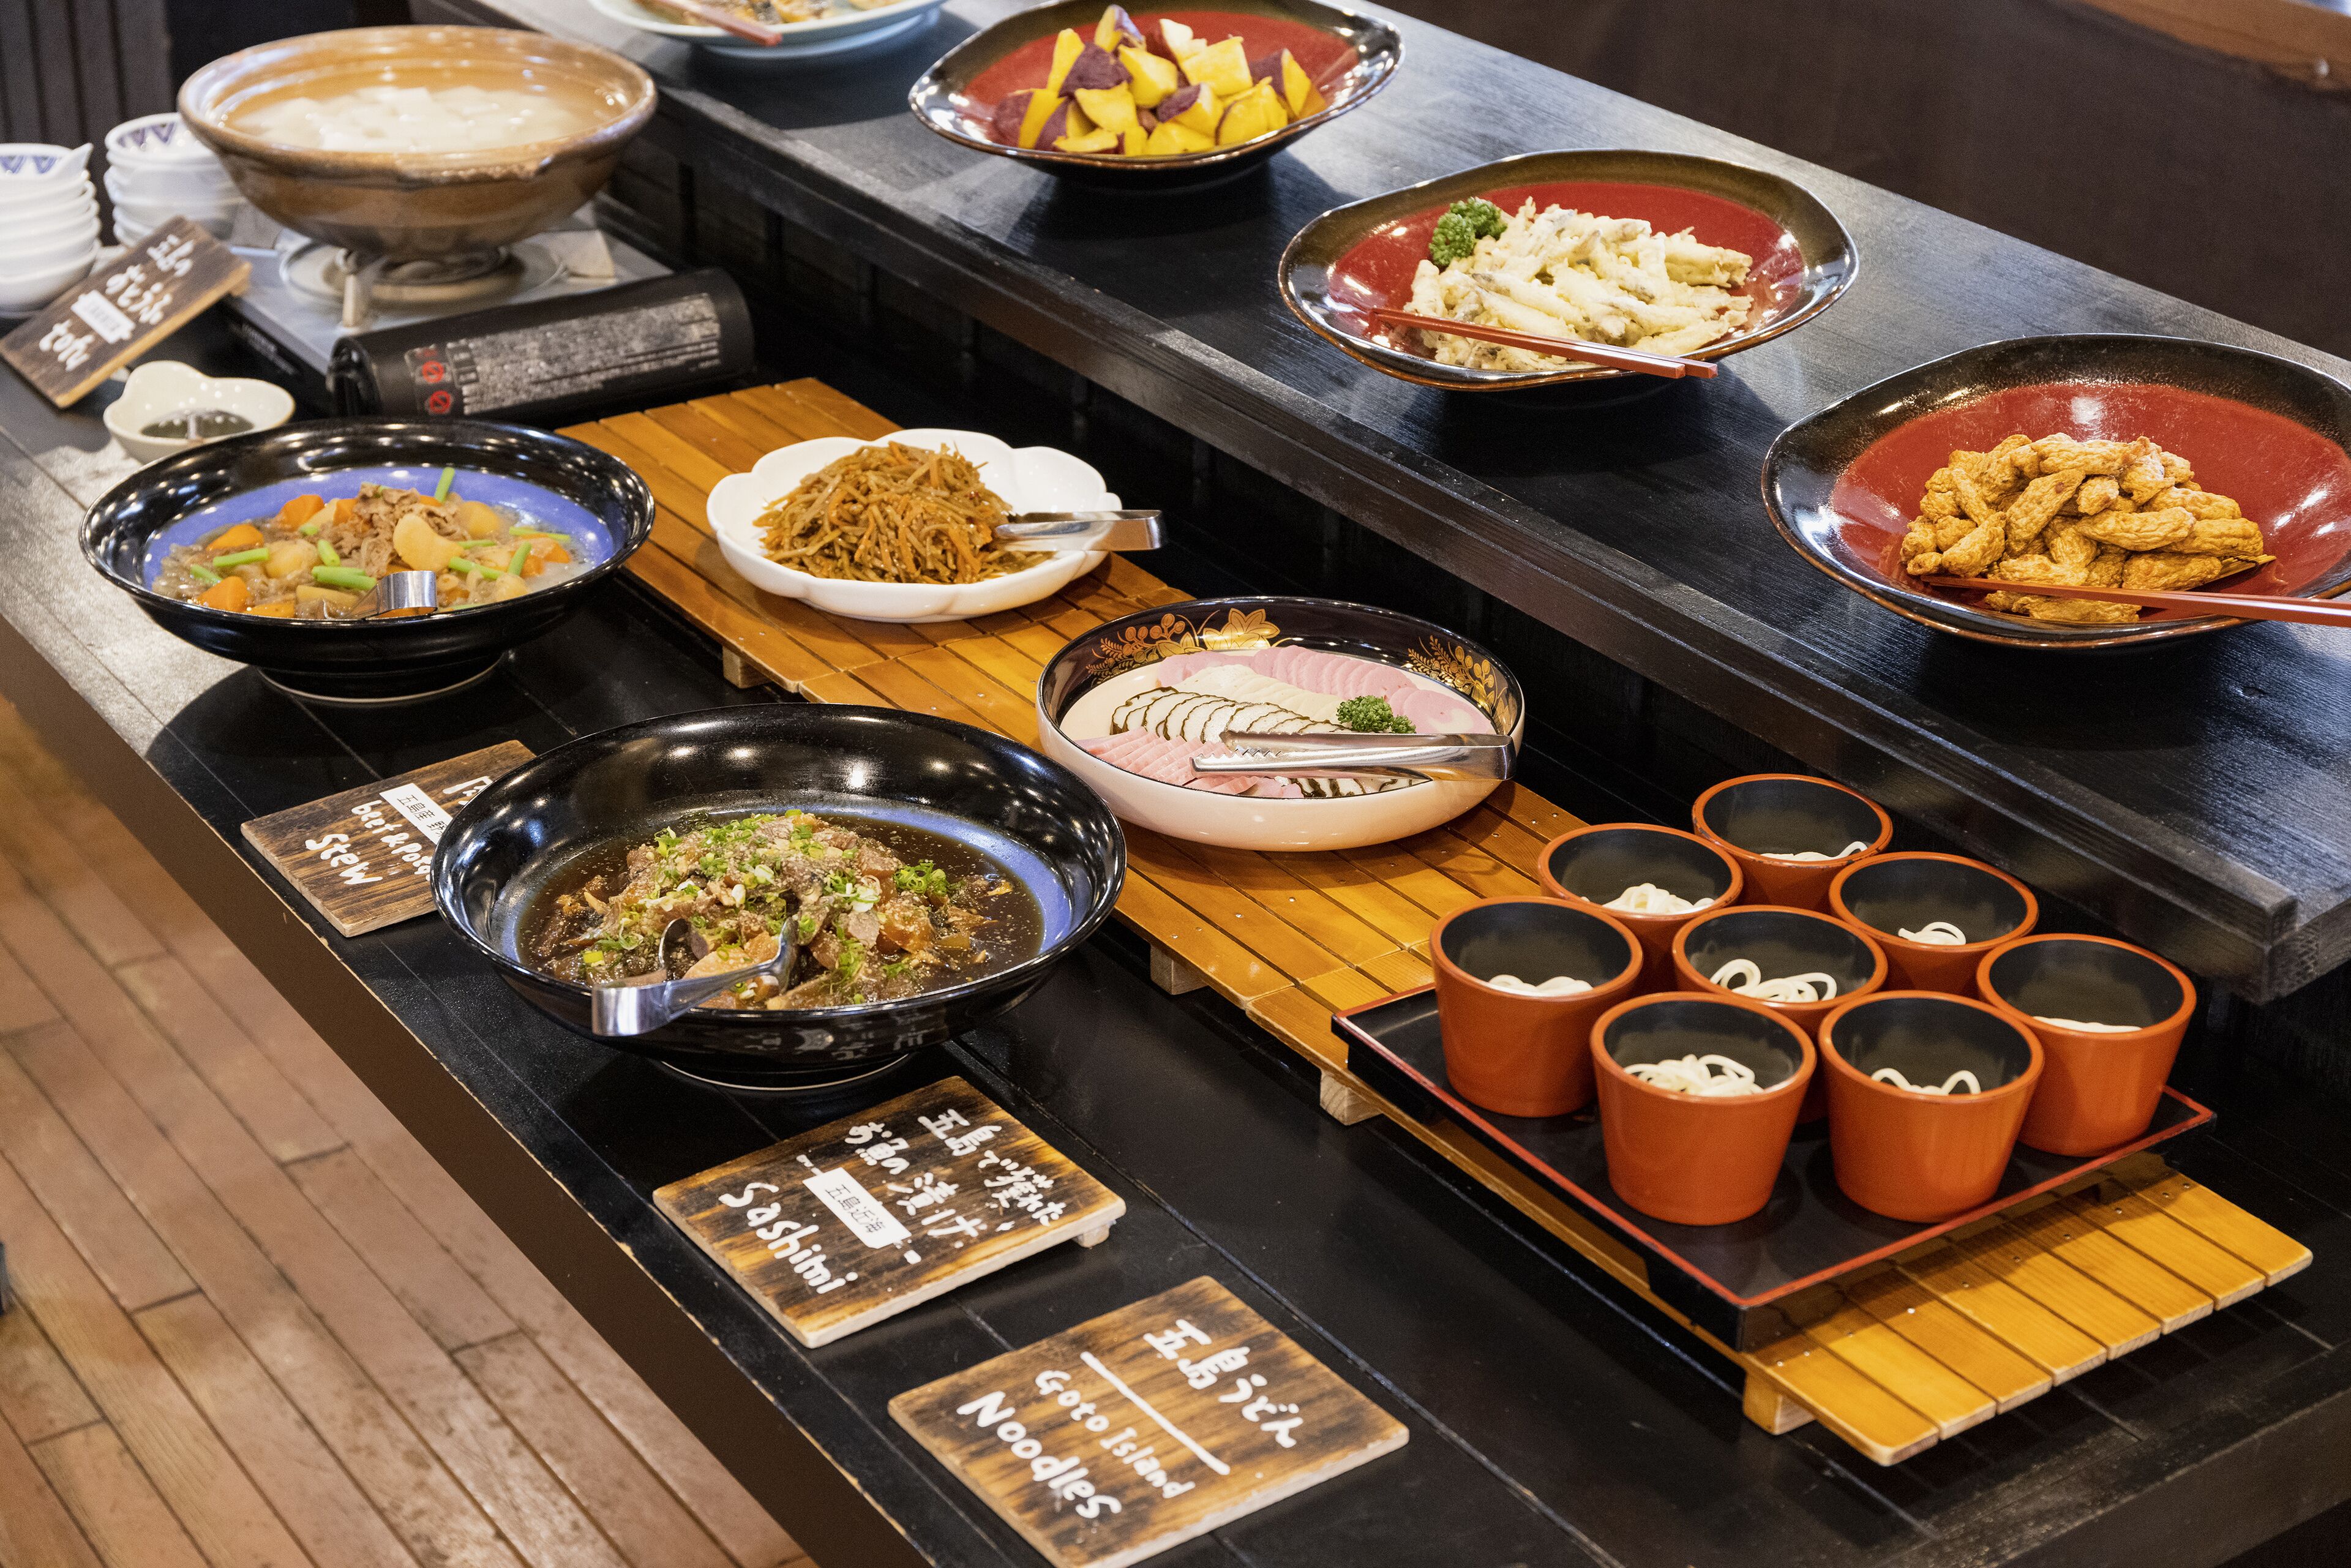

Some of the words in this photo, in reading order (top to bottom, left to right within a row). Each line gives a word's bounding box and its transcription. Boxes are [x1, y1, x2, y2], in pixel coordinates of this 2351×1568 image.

[105, 264, 172, 324] おとうふ
[39, 320, 94, 371] tofu
[397, 795, 435, 820] 五島産
[380, 833, 409, 847] &
[719, 1183, 858, 1294] Sashimi
[825, 1185, 886, 1233] 五島近海
[1144, 1319, 1303, 1447] 五島うどん
[957, 1392, 1121, 1518] Noodles
[1036, 1371, 1109, 1431] Goto
[1100, 1428, 1194, 1498] Island
